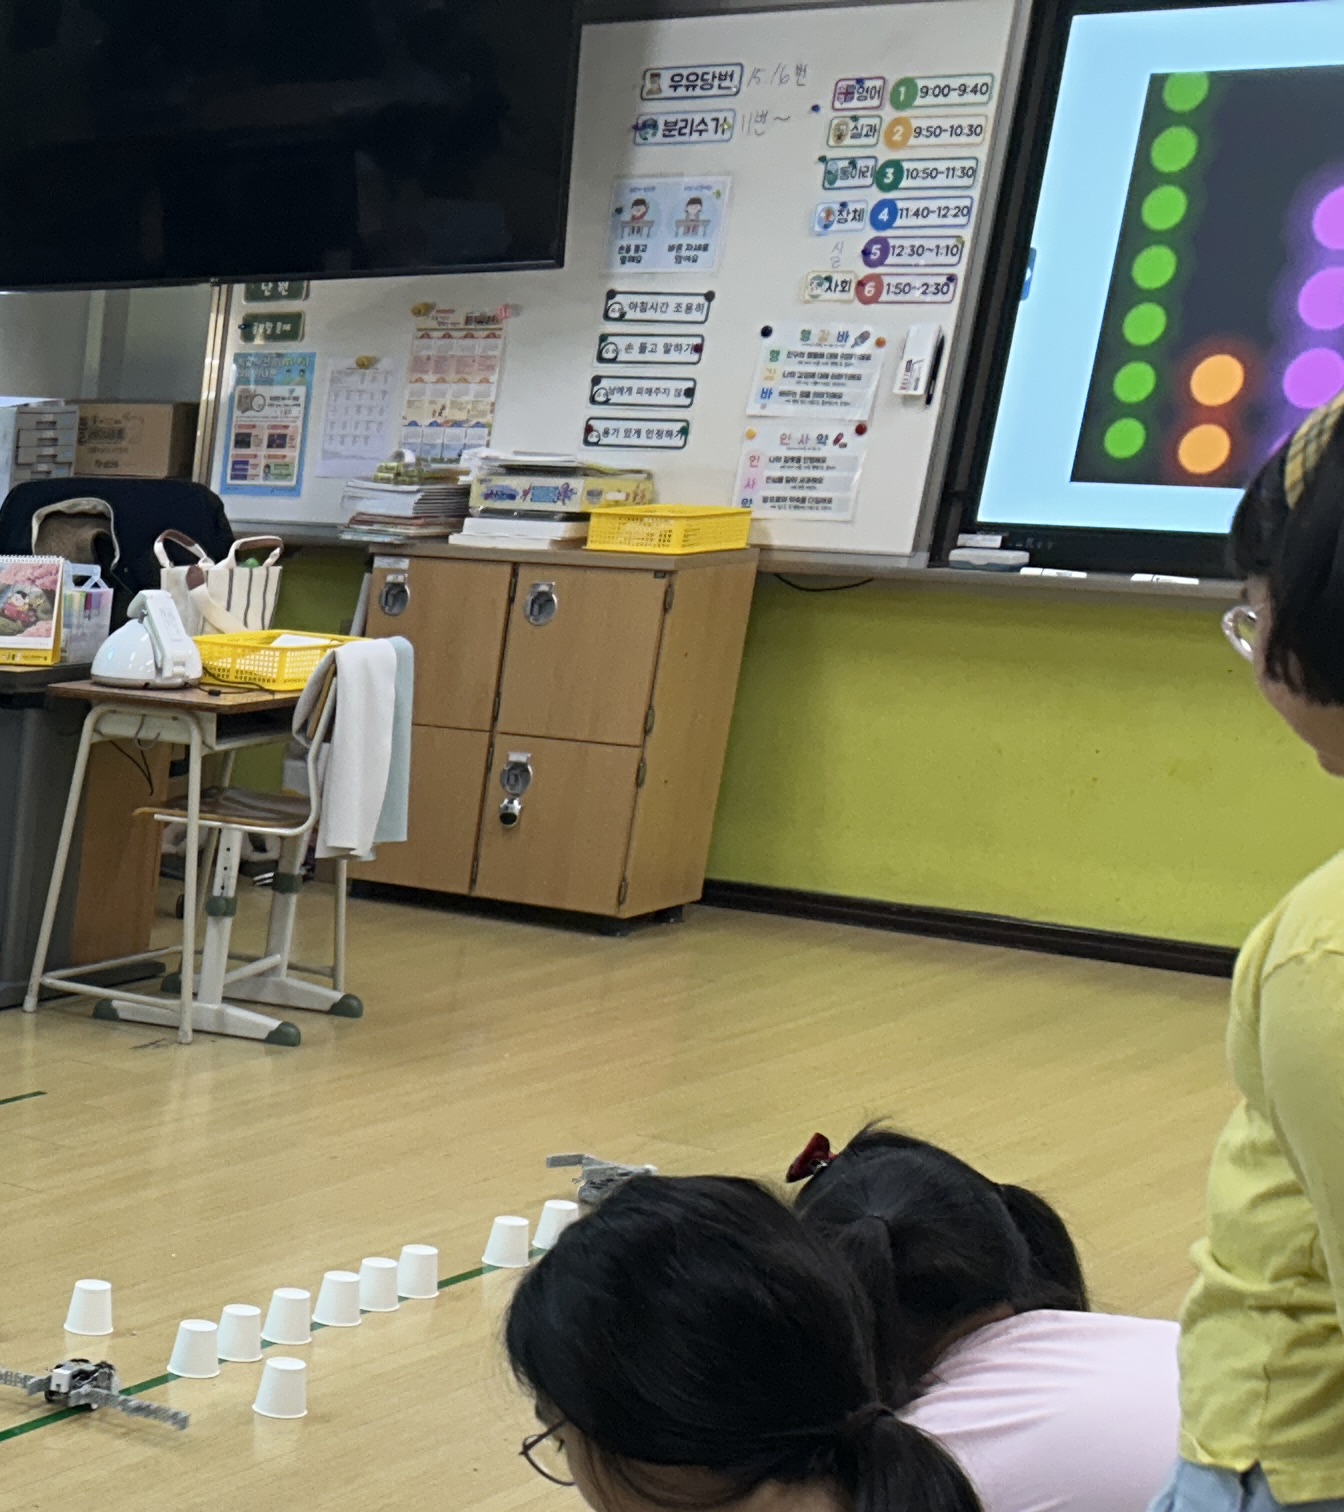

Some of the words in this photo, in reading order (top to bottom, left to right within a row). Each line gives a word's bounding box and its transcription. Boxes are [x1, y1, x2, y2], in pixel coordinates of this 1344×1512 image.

[669, 70, 734, 92] 우유당번
[856, 84, 881, 102] 영어
[899, 88, 905, 102] 1
[850, 124, 877, 139] 실과
[892, 126, 902, 141] 2
[883, 169, 895, 183] 3
[878, 207, 889, 222] 4
[869, 244, 882, 258] 5
[825, 278, 852, 294] 사회
[864, 282, 875, 297] 6
[628, 301, 669, 313] 아침시간
[673, 302, 705, 314] 조용히
[624, 343, 634, 353] 손
[638, 343, 658, 354] 들고
[662, 343, 694, 354] 말하기
[623, 428, 641, 438] 있게
